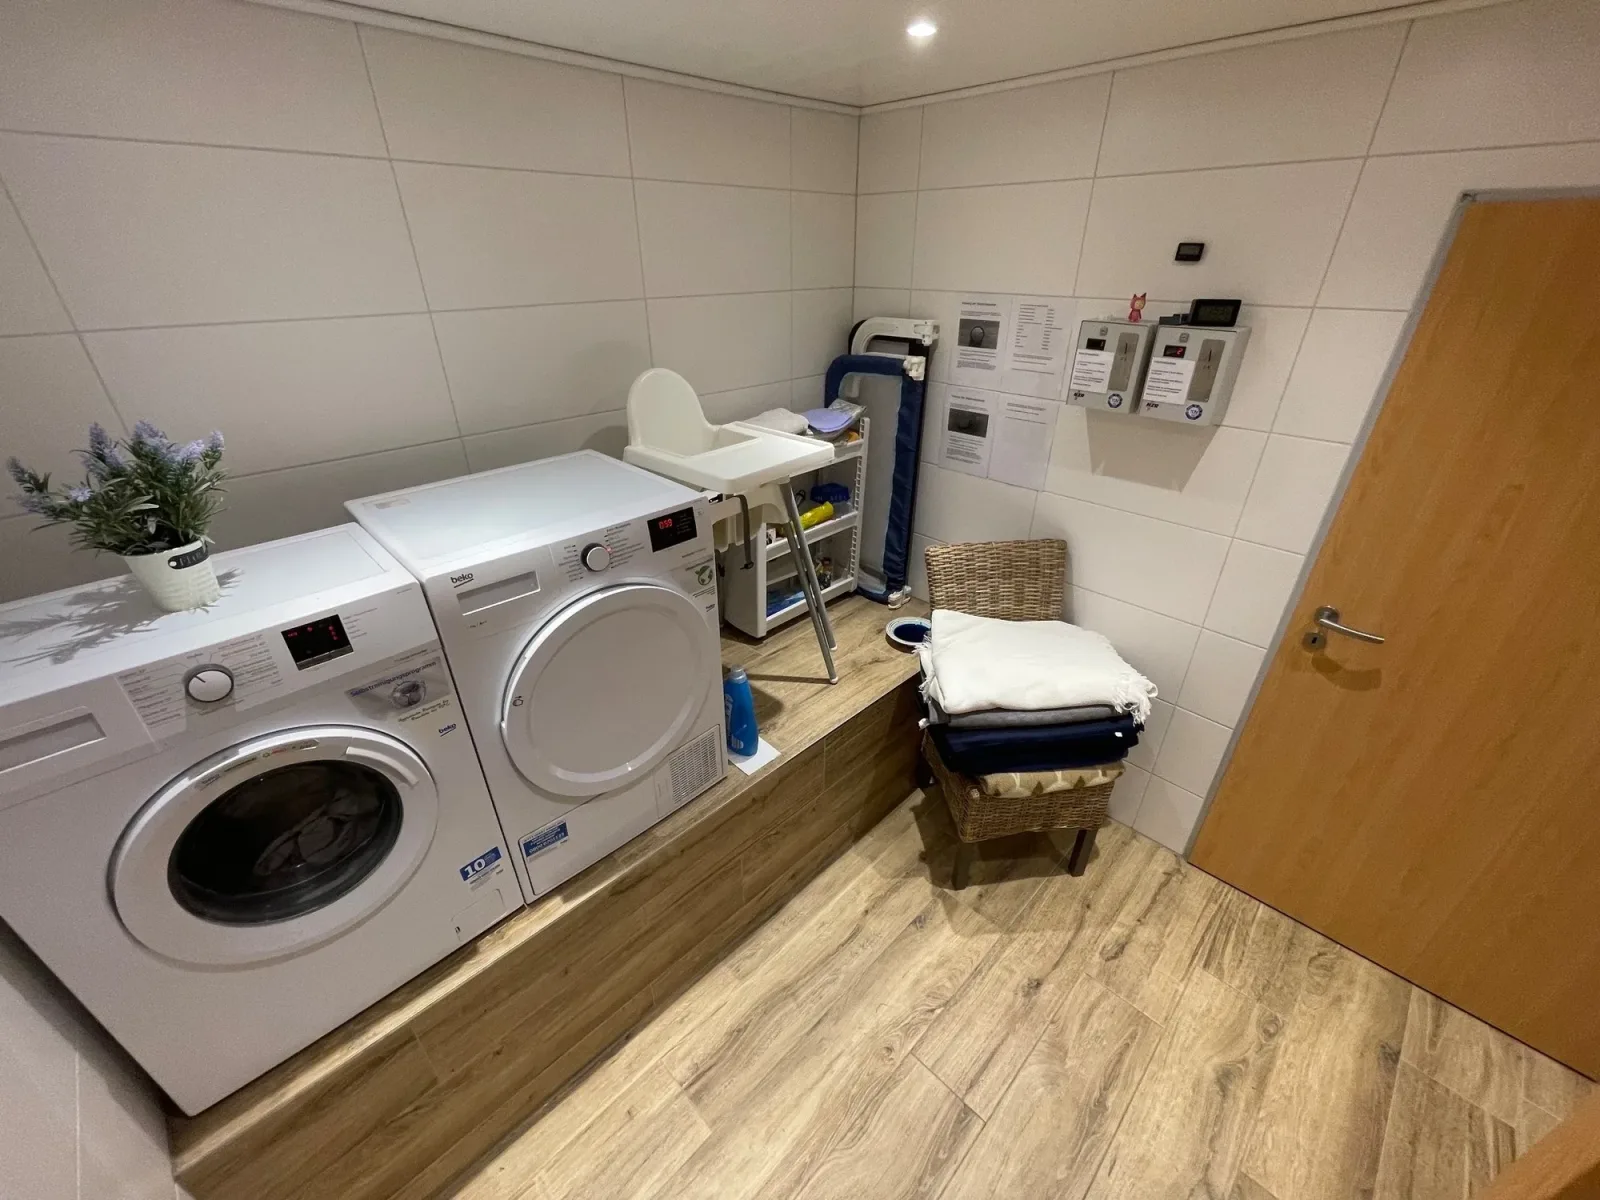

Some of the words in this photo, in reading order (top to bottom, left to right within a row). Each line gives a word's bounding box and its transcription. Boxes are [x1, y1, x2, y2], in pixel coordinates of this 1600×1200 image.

[450, 572, 474, 585] beko
[438, 723, 457, 735] beko
[463, 858, 486, 878] 10
